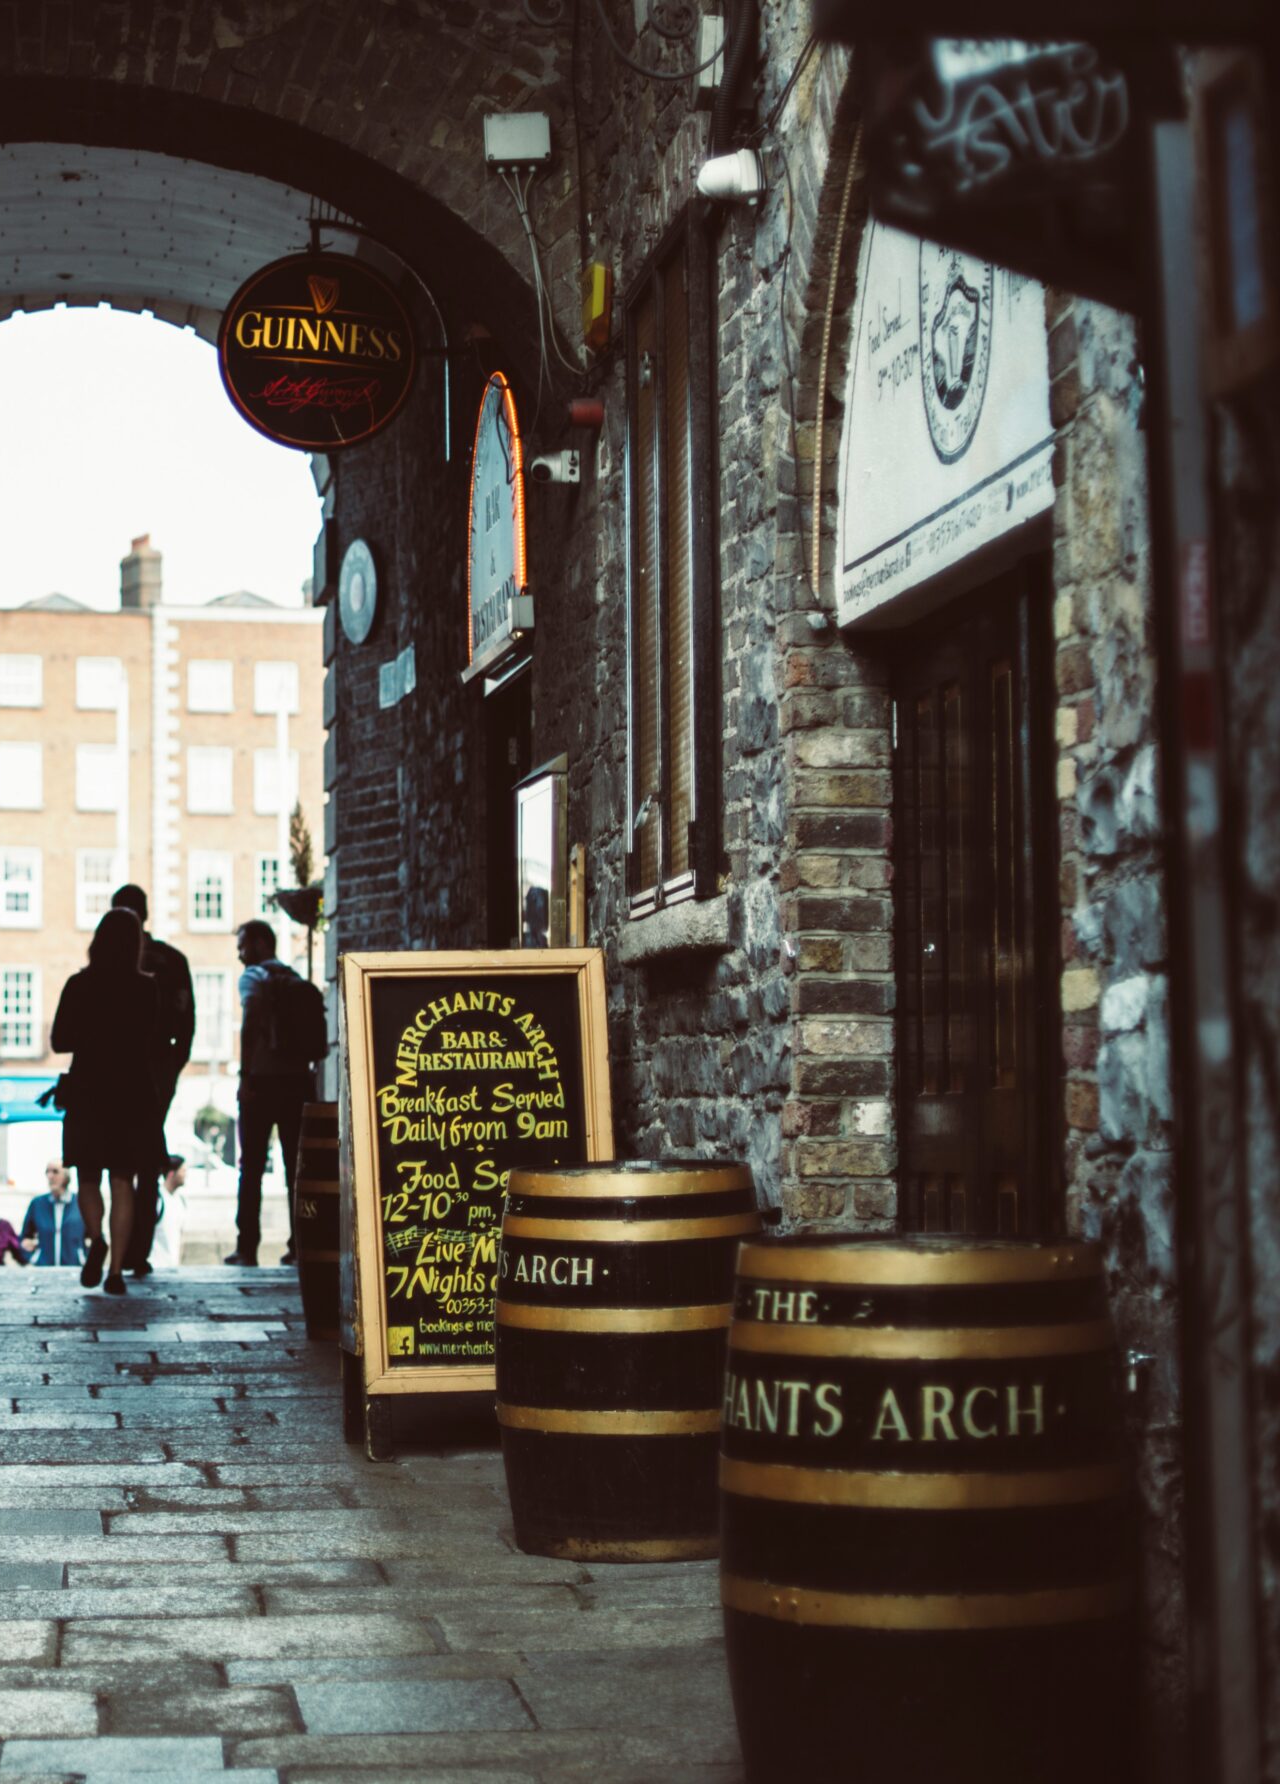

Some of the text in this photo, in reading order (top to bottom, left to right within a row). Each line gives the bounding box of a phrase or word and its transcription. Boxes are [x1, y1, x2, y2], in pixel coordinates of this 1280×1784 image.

[235, 311, 402, 362] GUINNESS
[396, 991, 560, 1088] MERCHANTS ARCH
[419, 1050, 537, 1072] RESTAURANT
[377, 1083, 565, 1118] Breakfast Served
[382, 1112, 569, 1151] Daily from 9am
[397, 1160, 460, 1193] Food
[416, 1232, 466, 1266] Live
[385, 1266, 409, 1298] 7
[406, 1265, 486, 1303] Nights
[514, 1255, 594, 1285] ARCH
[755, 1289, 819, 1323] THE
[872, 1384, 1045, 1441] ARCH
